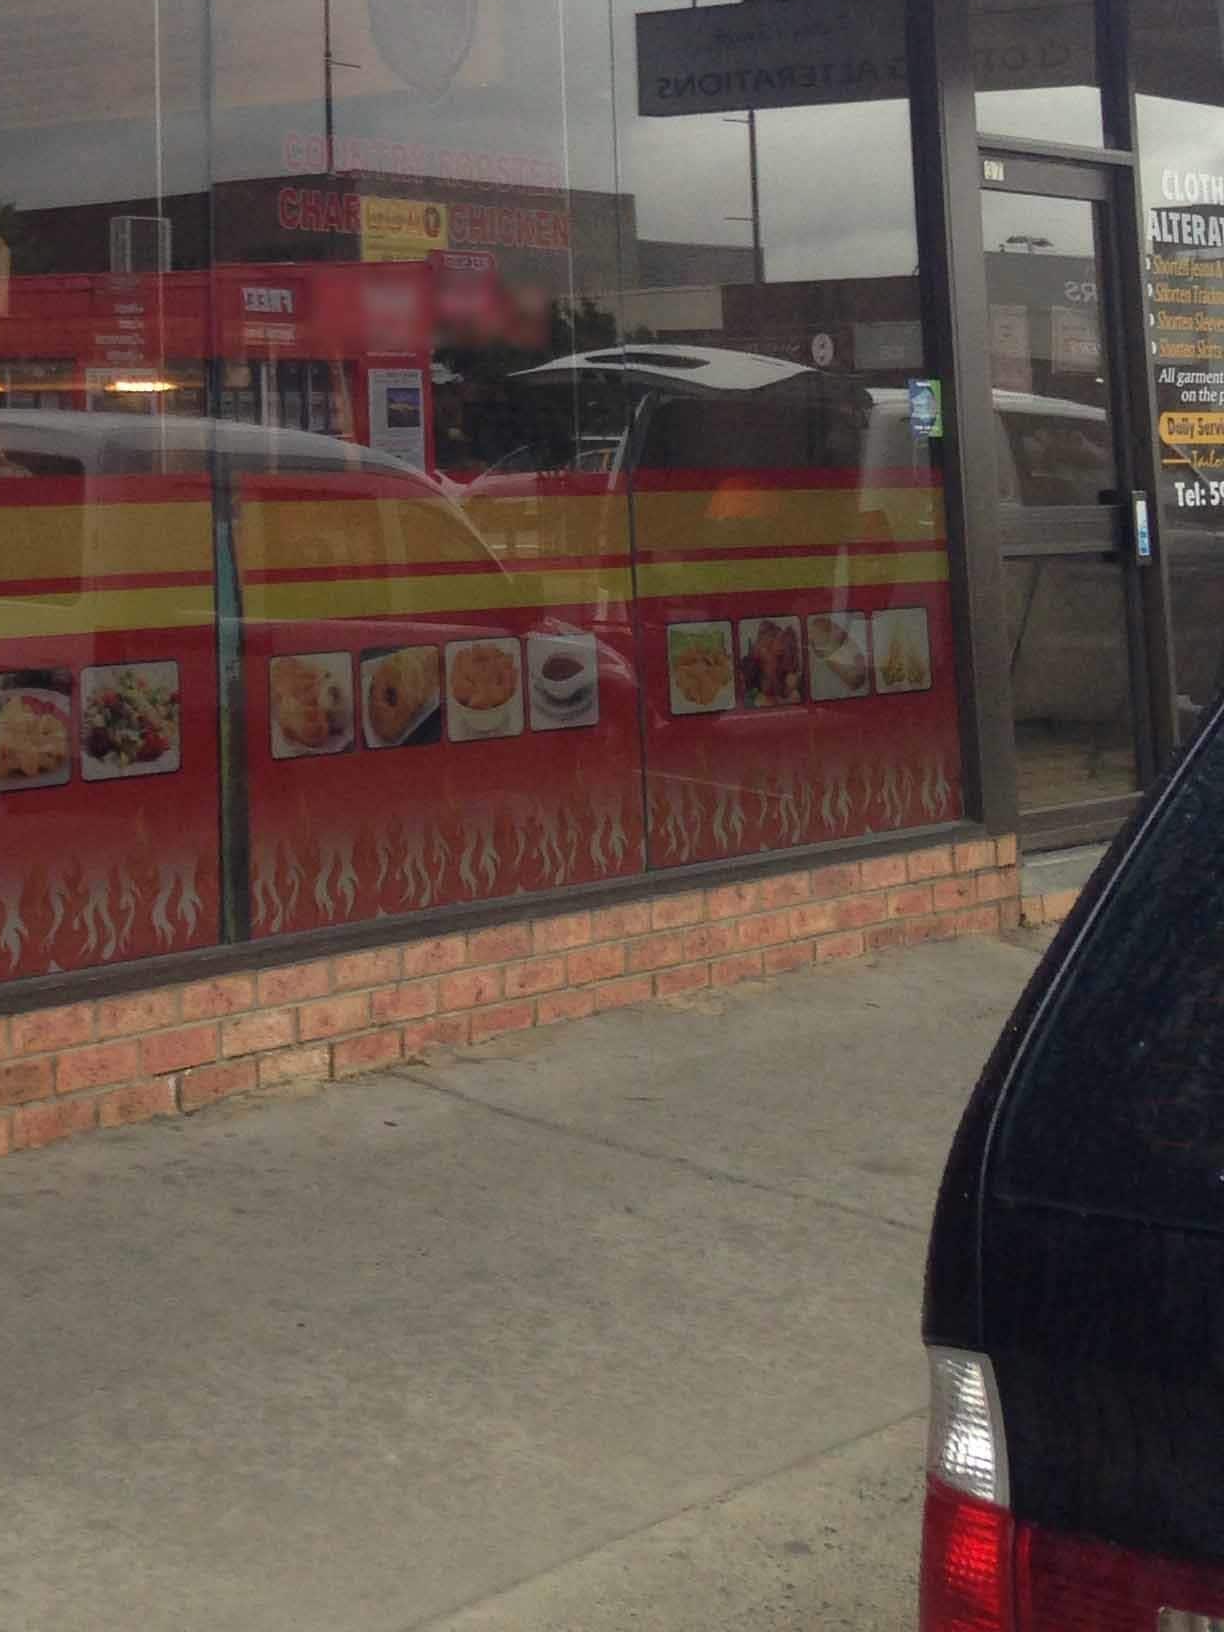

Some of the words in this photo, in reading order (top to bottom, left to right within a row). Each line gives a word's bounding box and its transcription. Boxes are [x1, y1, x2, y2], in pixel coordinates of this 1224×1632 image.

[1161, 168, 1224, 206] CLOTH
[1159, 368, 1175, 383] All
[1181, 390, 1196, 402] on
[1198, 387, 1217, 402] the
[1174, 481, 1206, 507] Tel:
